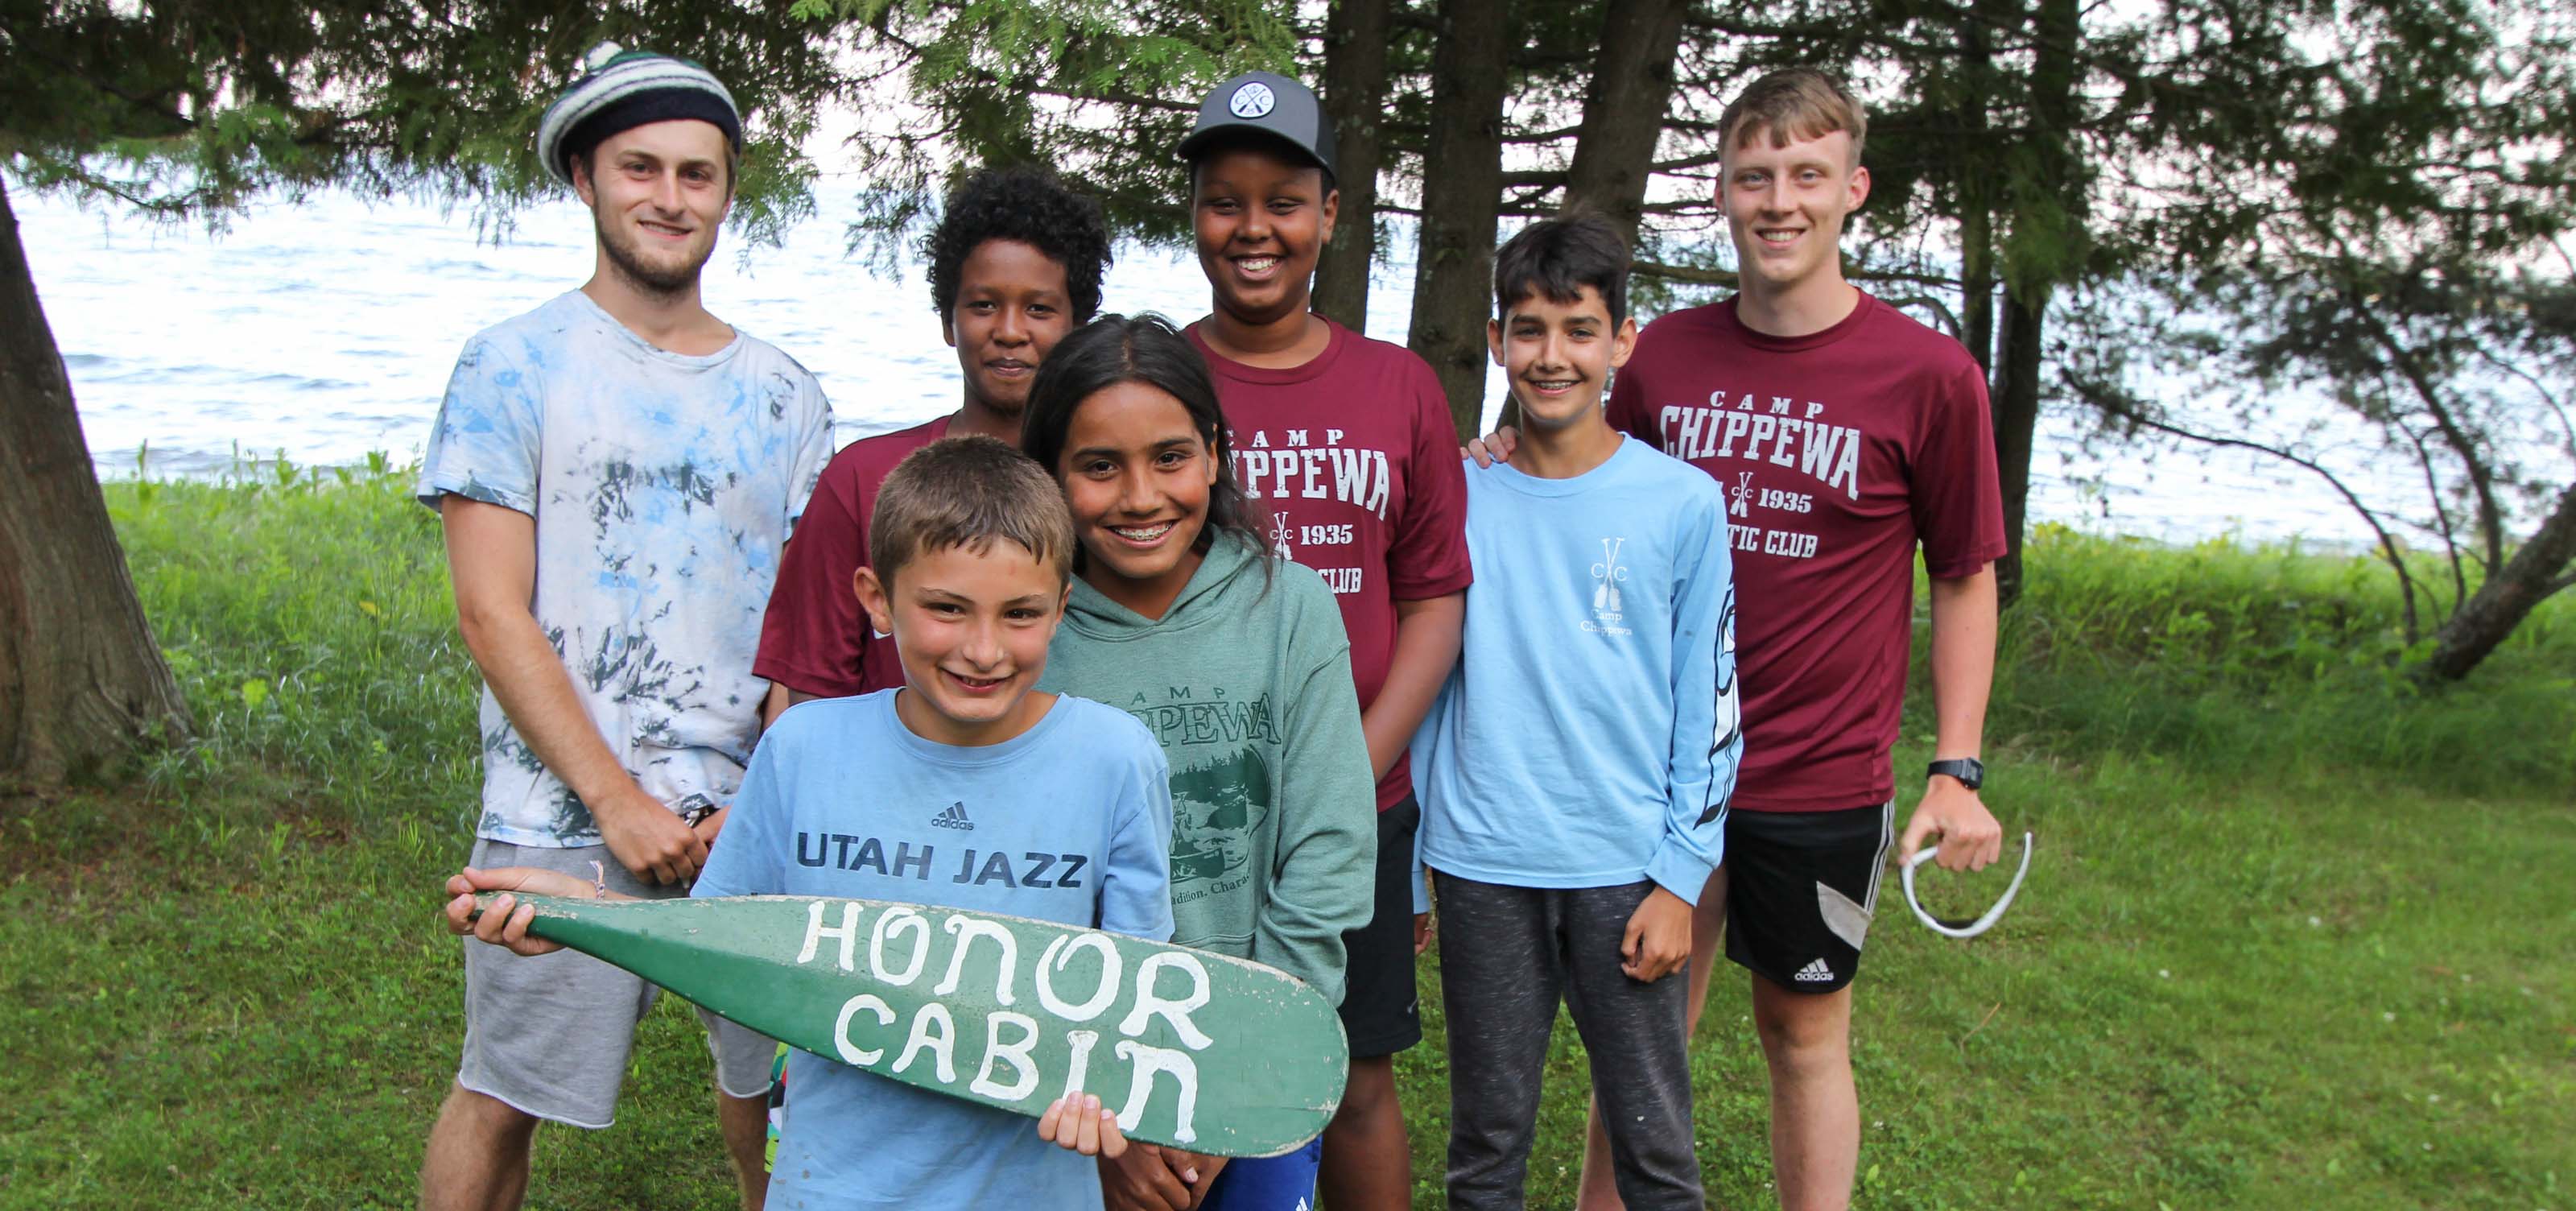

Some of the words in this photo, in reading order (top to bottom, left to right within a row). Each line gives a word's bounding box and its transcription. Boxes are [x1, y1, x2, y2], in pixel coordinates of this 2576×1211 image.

[1710, 391, 1823, 420] CAMP
[1660, 405, 1860, 502] CHIPPEWA
[1757, 488, 1813, 514] 1935
[1301, 524, 1353, 545] 1935
[1765, 530, 1818, 559] CLUB
[1591, 609, 1623, 623] Camp
[1103, 686, 1225, 705] AMP
[931, 818, 974, 830] adidas
[796, 831, 935, 881] UTAH
[952, 849, 1088, 889] JAZZ
[1172, 891, 1208, 904] adition.
[1794, 972, 1834, 982] adidas
